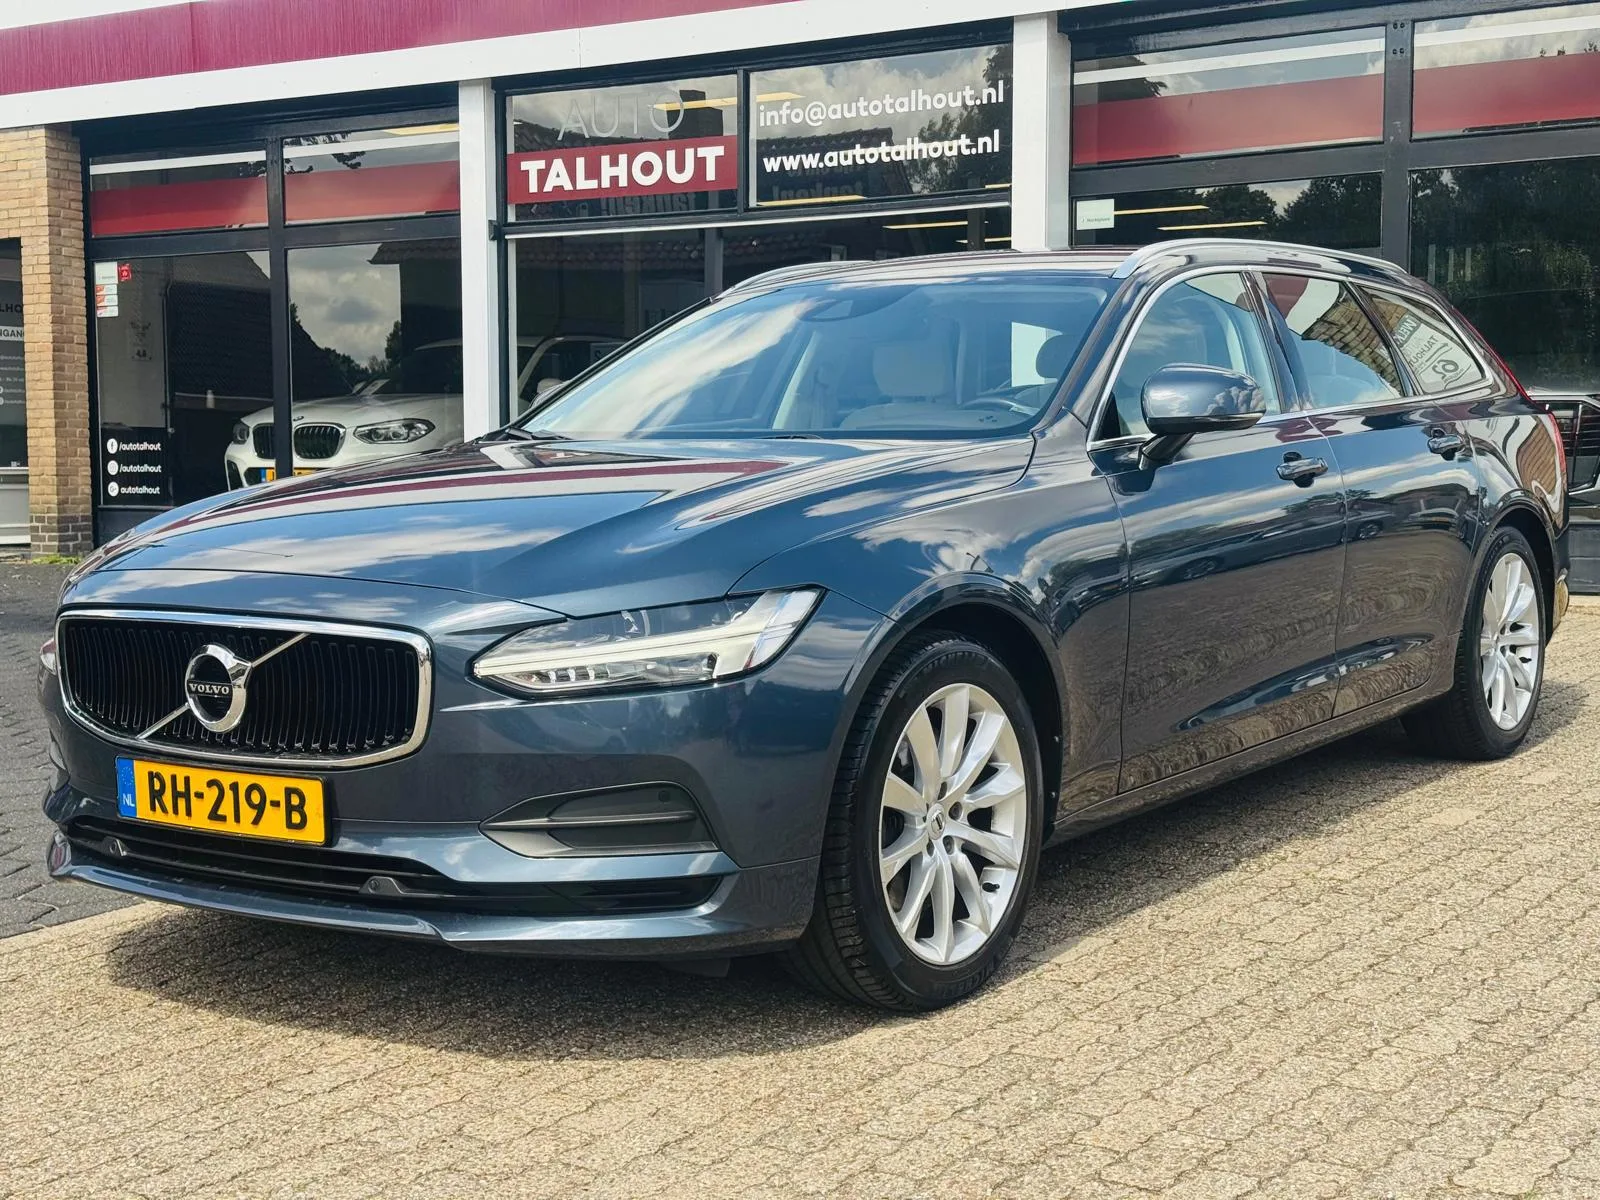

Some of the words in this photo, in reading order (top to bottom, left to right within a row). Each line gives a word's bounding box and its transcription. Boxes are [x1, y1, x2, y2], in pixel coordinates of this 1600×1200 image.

[557, 91, 685, 141] AUTO
[759, 80, 1005, 127] info@autotalhout.nl
[520, 145, 725, 193] TALHOUT
[763, 129, 1001, 173] www.autotalhout.nl
[120, 485, 160, 494] autotalhout
[189, 682, 230, 695] VOLVO
[123, 793, 135, 807] NL
[147, 770, 308, 831] RH-219-B
